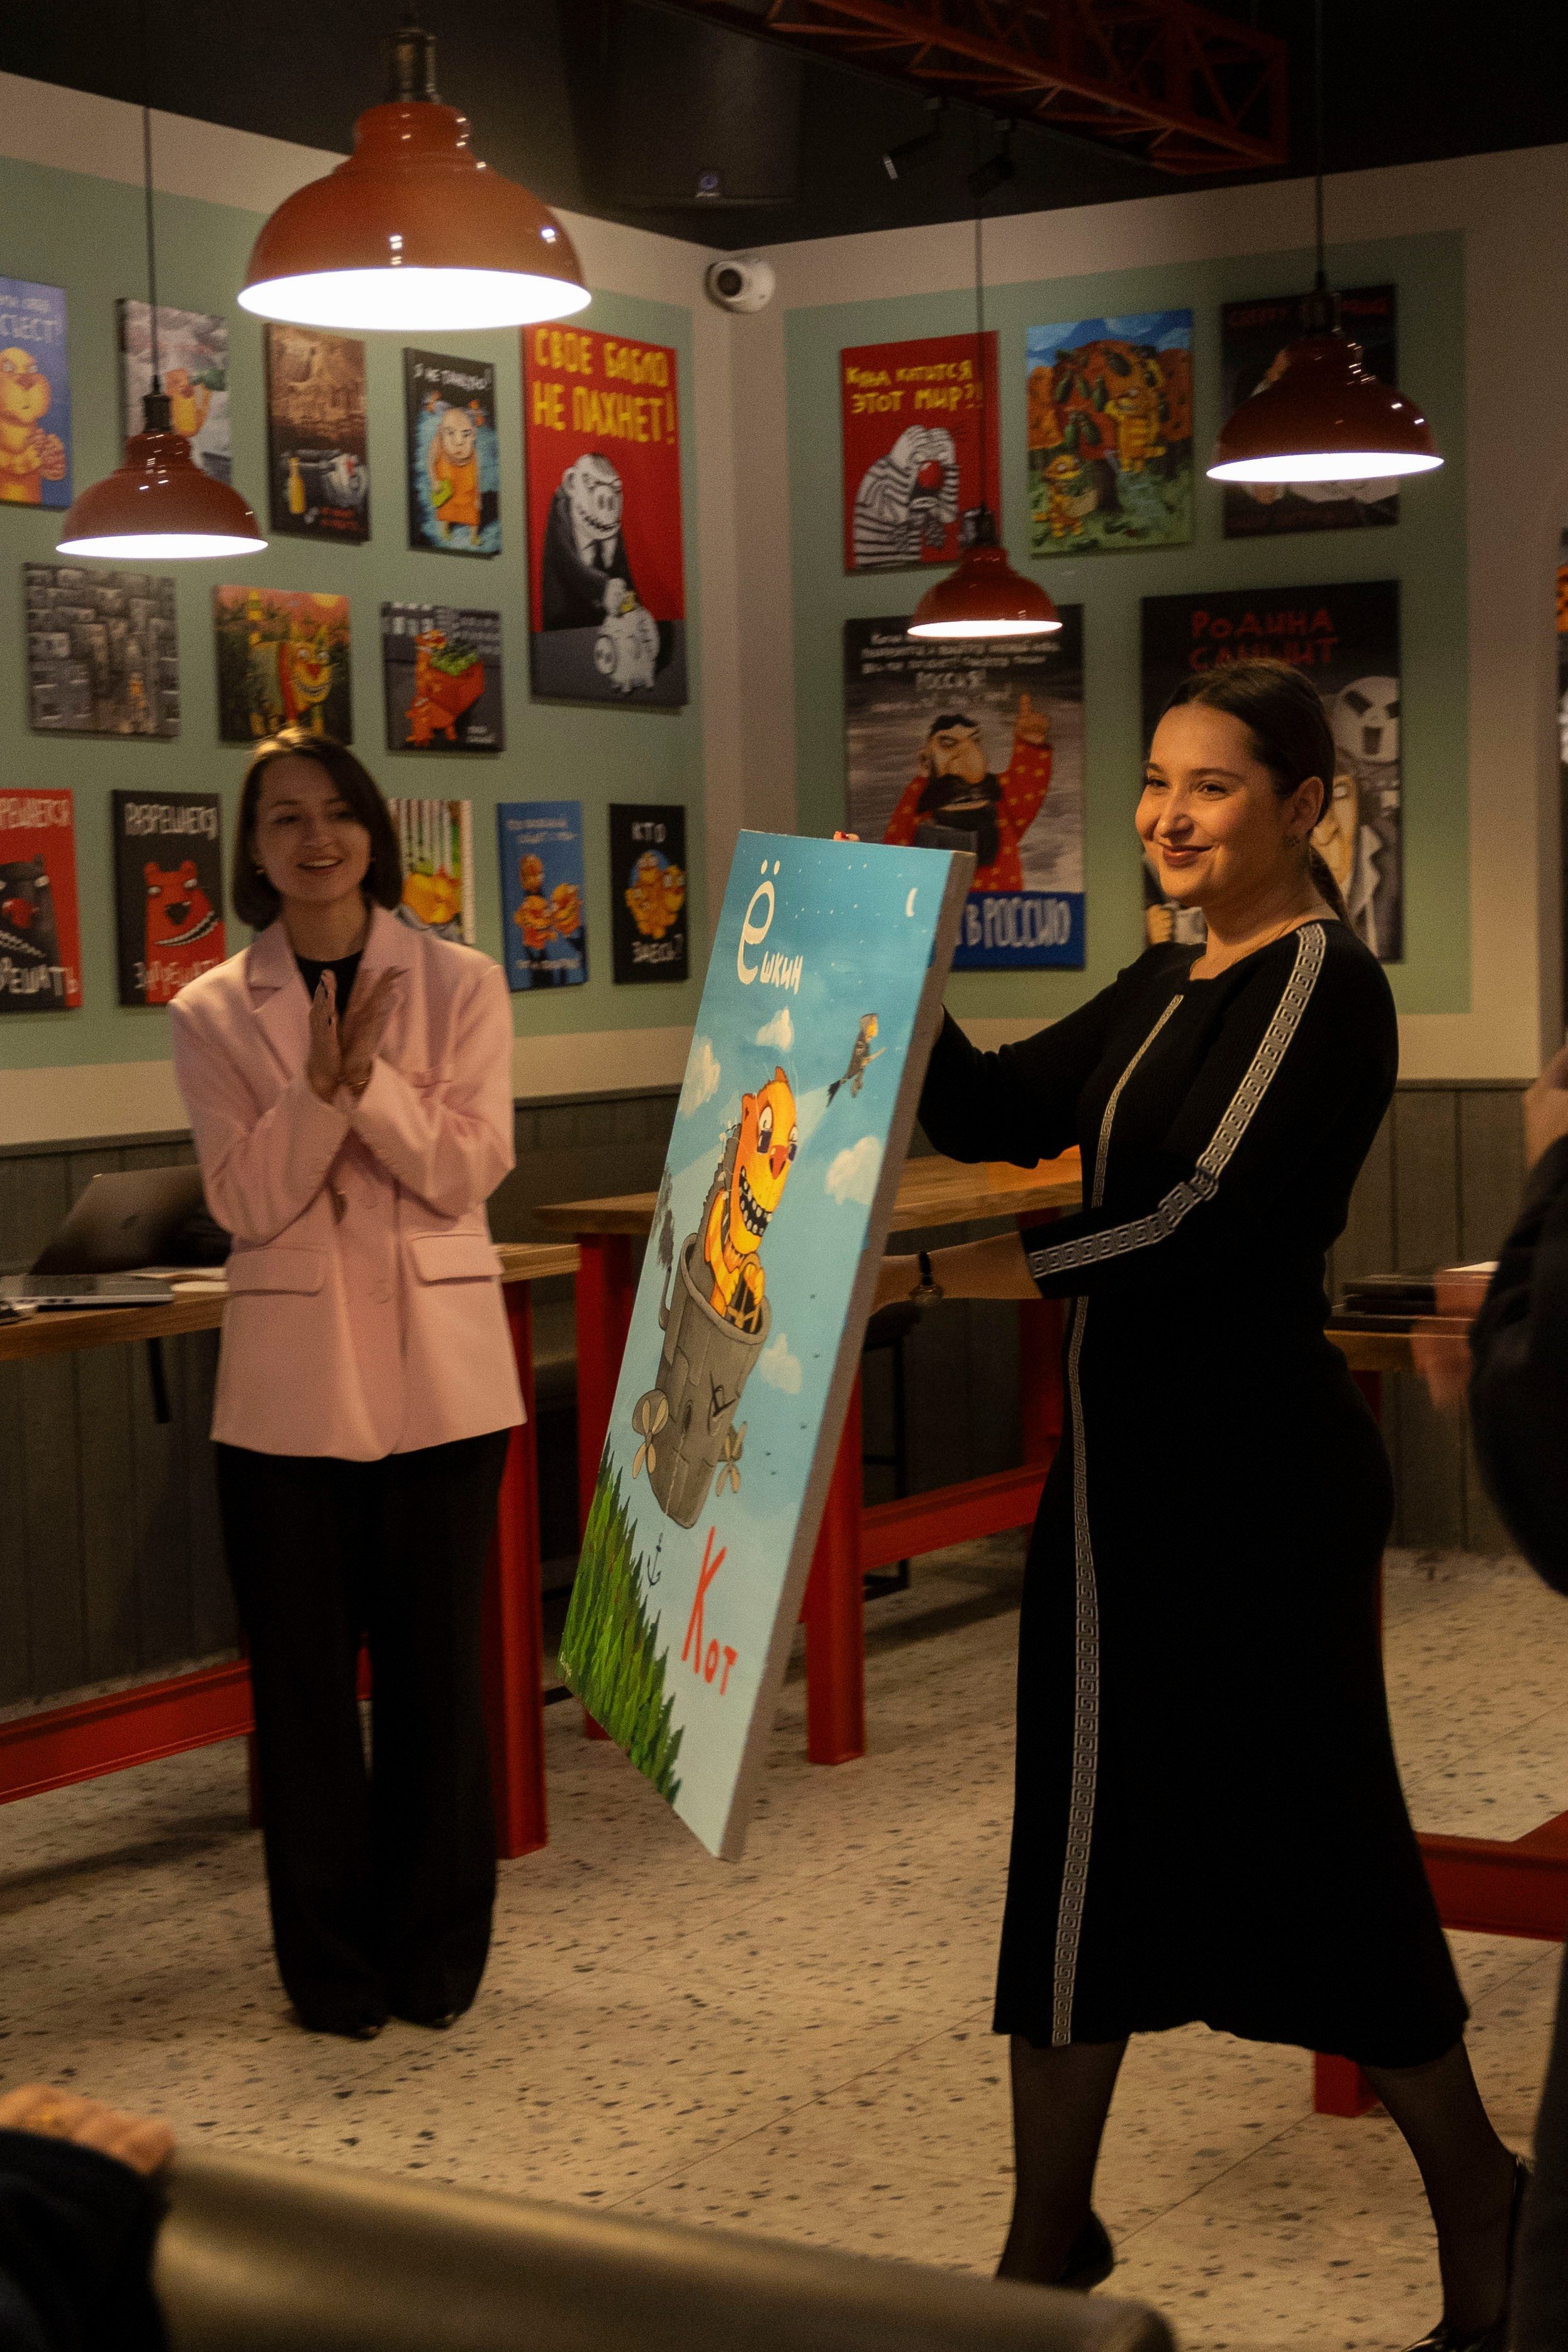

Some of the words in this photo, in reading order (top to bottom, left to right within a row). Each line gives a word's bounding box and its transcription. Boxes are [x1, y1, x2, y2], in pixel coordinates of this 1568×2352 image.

[535, 328, 593, 372] СВОЕ
[604, 342, 669, 388] БАБЛО
[533, 381, 566, 429] НЕ
[573, 385, 676, 445] ПАХНЕТ!
[851, 390, 905, 415] ЭТОТ
[632, 820, 666, 844] КТО
[965, 903, 982, 947] В
[983, 897, 1072, 949] РОССИЮ
